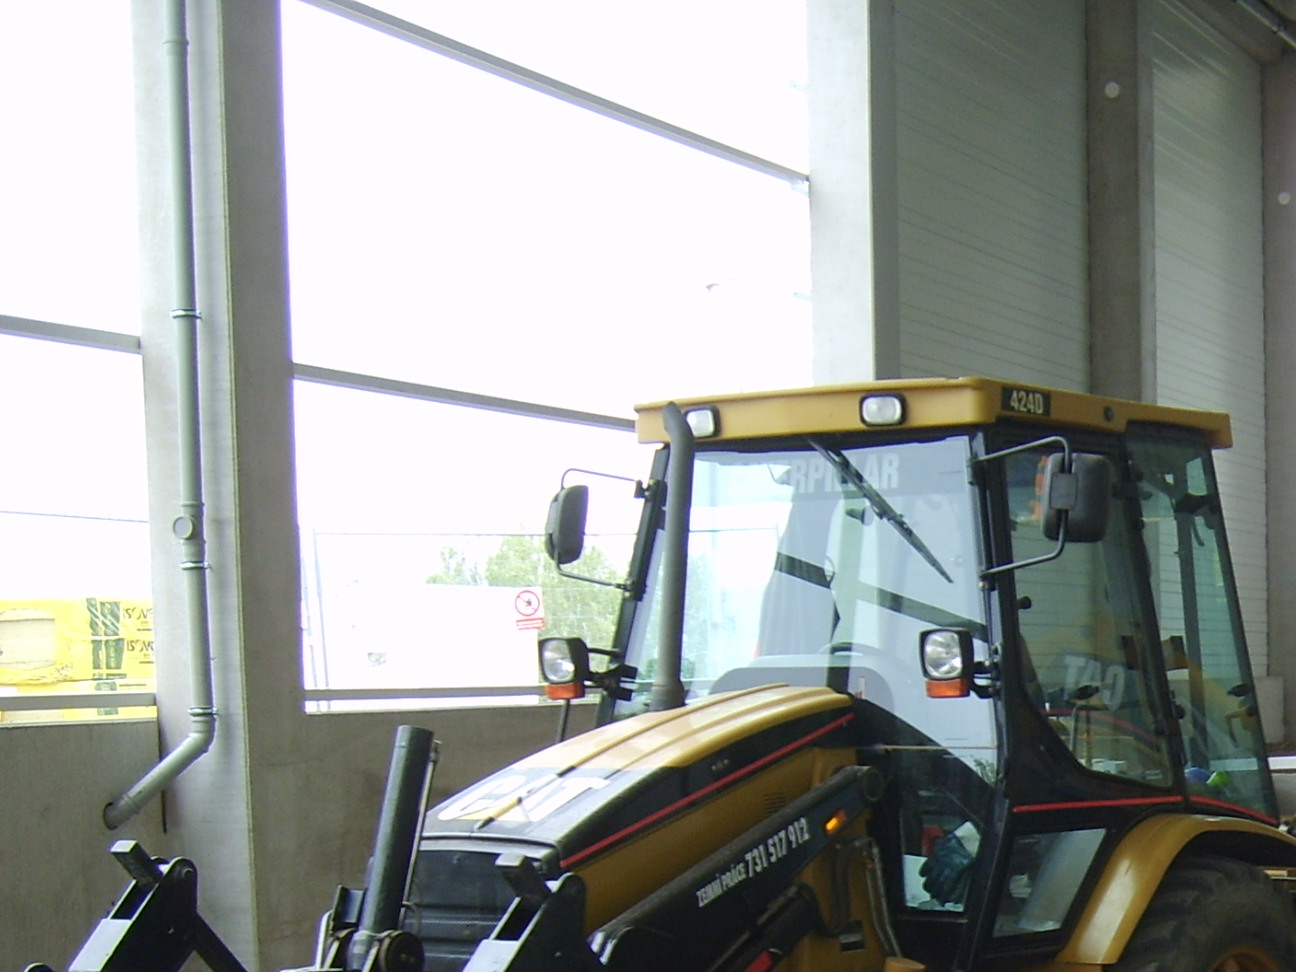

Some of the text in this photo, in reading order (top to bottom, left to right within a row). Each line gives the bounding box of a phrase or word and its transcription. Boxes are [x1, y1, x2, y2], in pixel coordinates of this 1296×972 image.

[1010, 389, 1044, 414] 424D
[744, 844, 768, 878] 731
[767, 829, 788, 863] 517
[788, 817, 810, 849] 912
